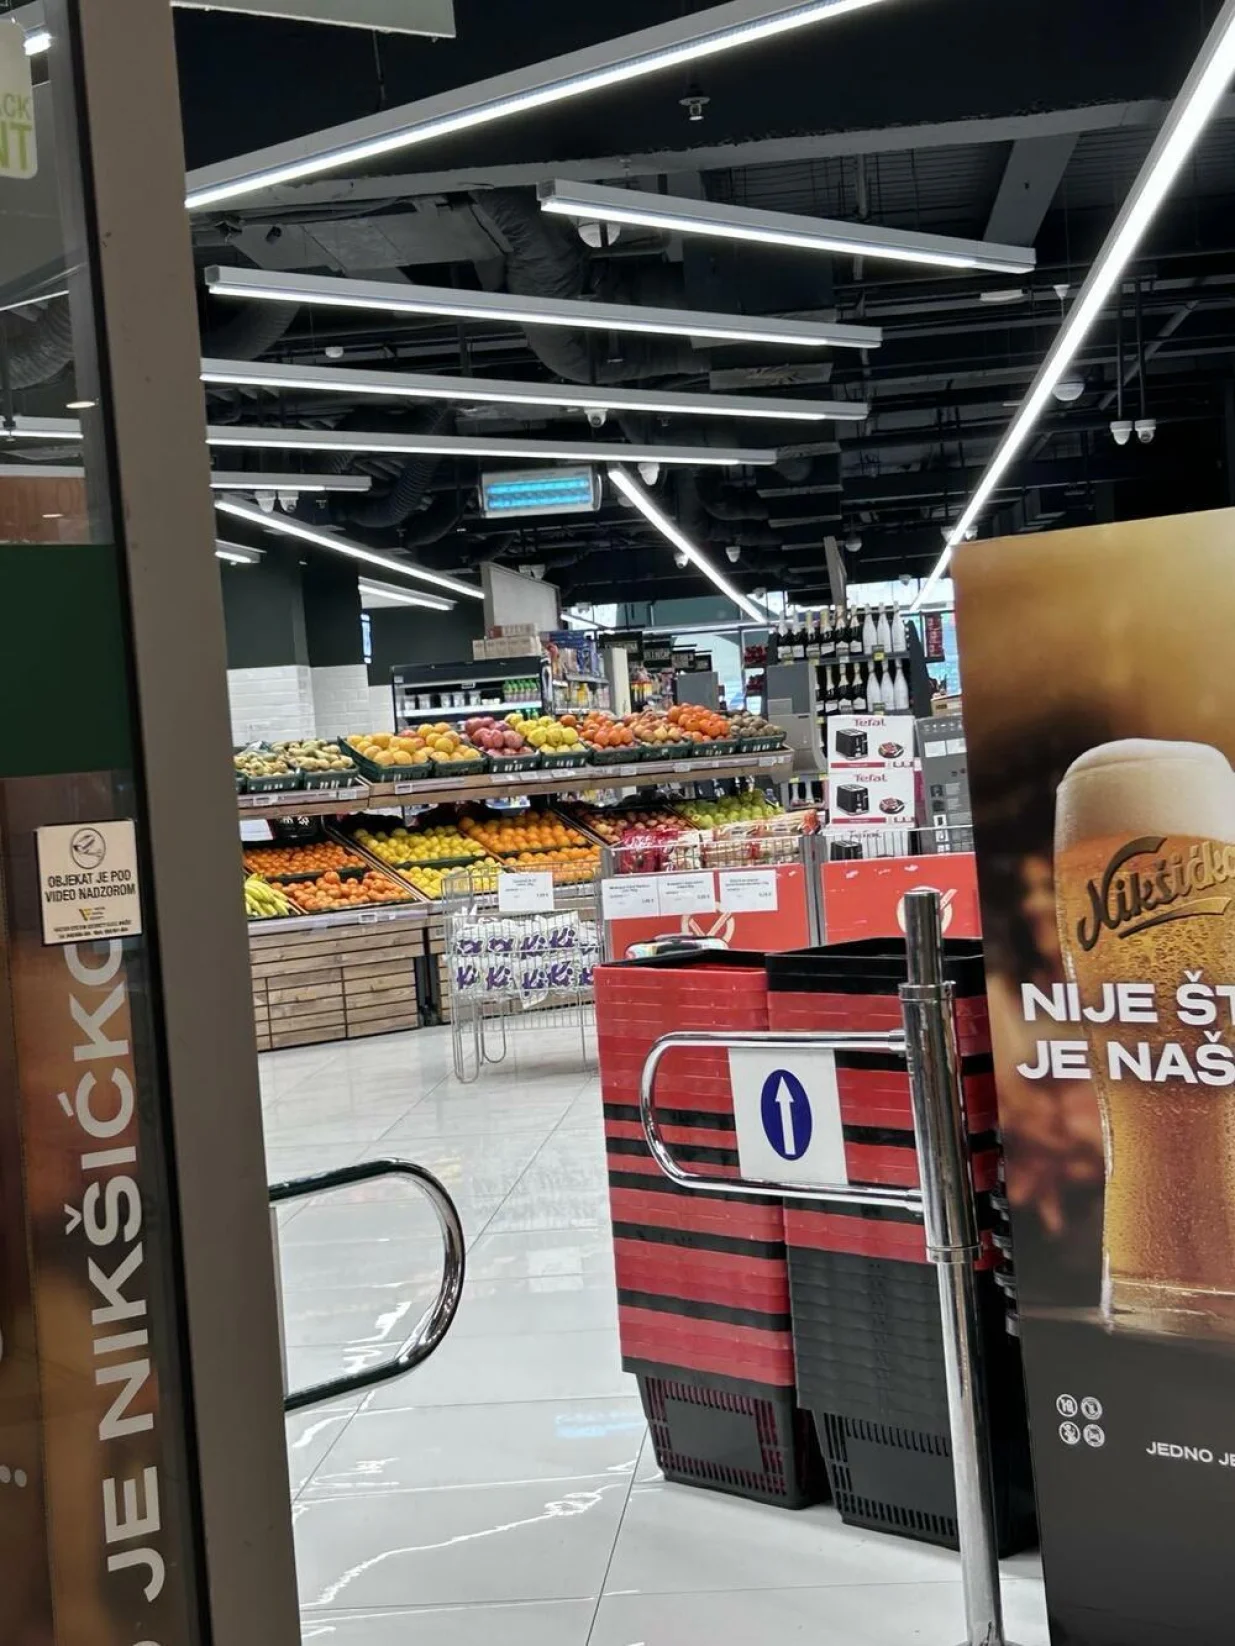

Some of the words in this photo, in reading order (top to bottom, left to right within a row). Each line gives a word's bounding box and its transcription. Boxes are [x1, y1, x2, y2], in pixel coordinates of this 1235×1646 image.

[855, 774, 887, 783] Tefal
[48, 873, 93, 888] OBJEKAT
[96, 871, 109, 884] JE
[110, 869, 131, 882] POD
[45, 888, 76, 902] VIDEO
[79, 883, 136, 899] NADZOROM
[1021, 982, 1158, 1023] NIJE
[1016, 1040, 1092, 1079] JE
[1145, 1441, 1214, 1463] JEDNO
[103, 1466, 165, 1603] JE
